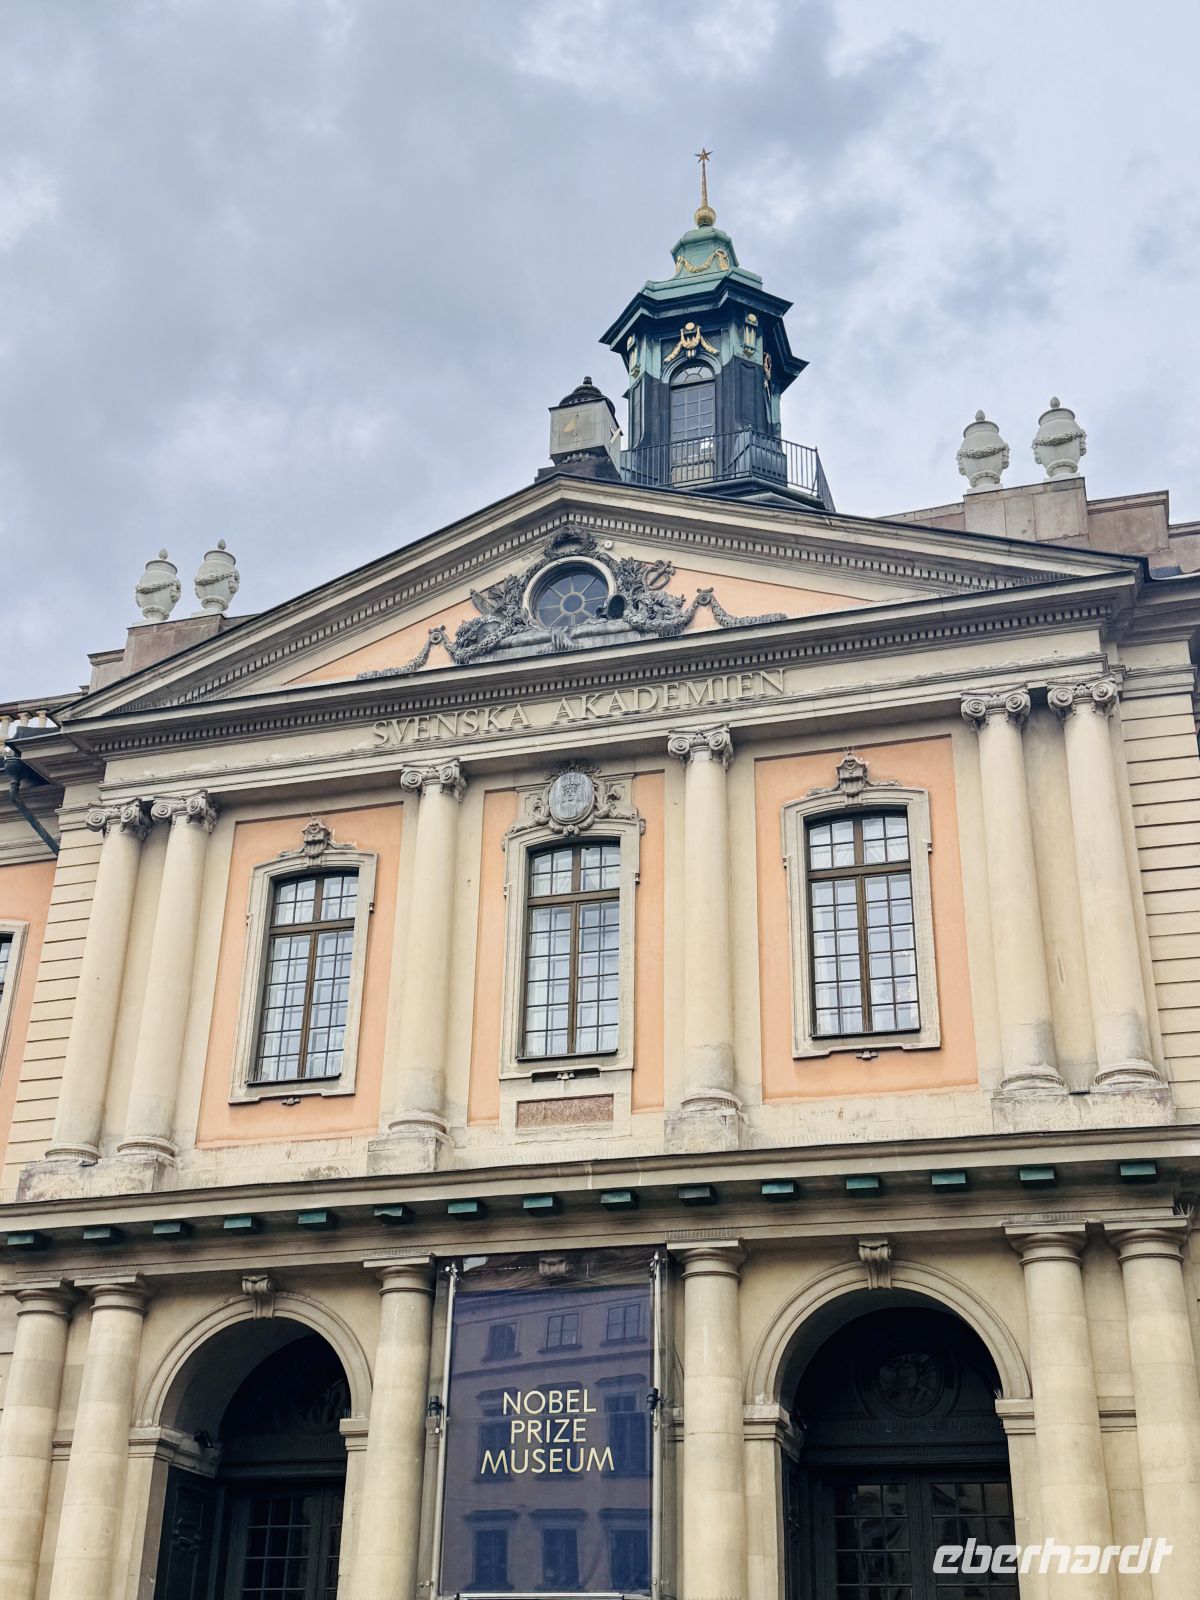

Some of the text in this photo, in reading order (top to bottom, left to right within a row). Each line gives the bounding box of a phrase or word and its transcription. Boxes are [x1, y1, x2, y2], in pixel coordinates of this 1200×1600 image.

[372, 669, 786, 747] SVENSKA AKADEMIEN
[503, 1389, 597, 1415] NOBEL
[510, 1418, 587, 1444] PRIZE
[480, 1446, 615, 1474] MUSEUM
